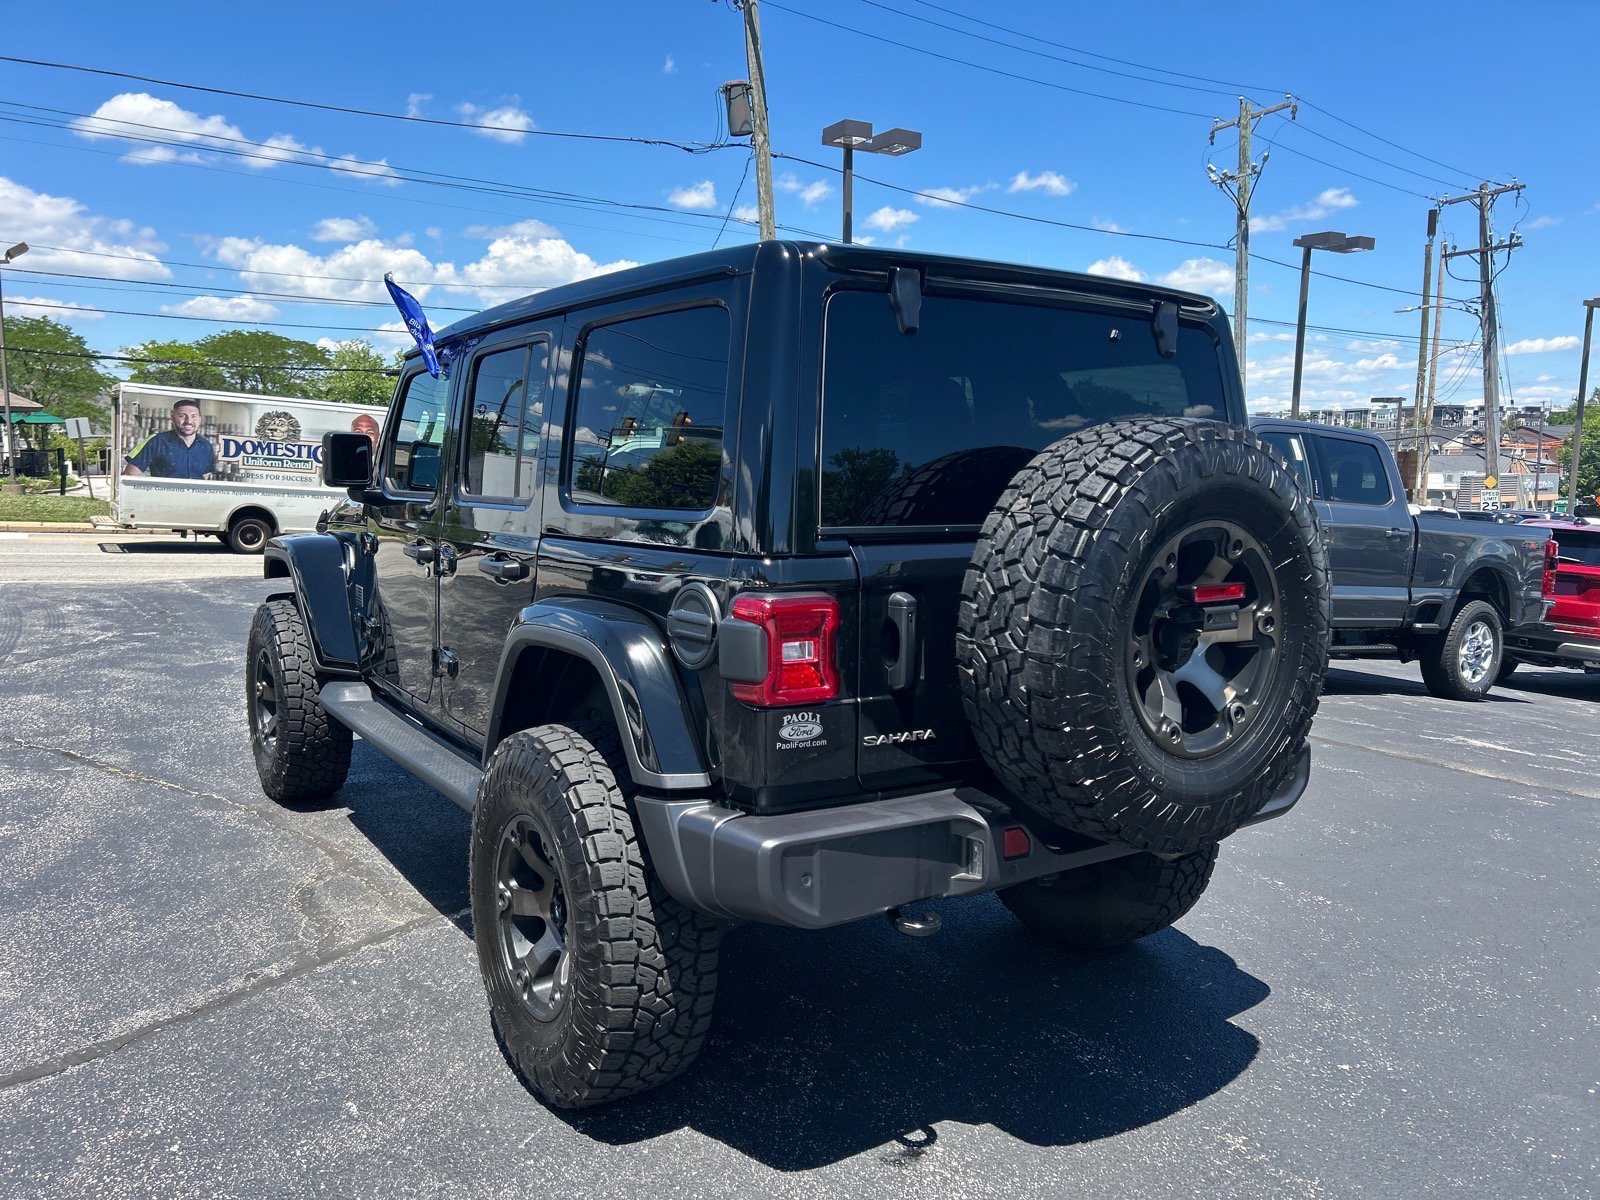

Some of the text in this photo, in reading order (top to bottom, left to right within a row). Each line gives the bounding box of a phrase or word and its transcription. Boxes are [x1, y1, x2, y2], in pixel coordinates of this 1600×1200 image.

[222, 438, 323, 465] DOMESTIC
[244, 456, 312, 470] Uniform Rental
[265, 473, 281, 481] FOR
[1482, 501, 1499, 511] 25
[783, 711, 821, 726] PAOLI
[789, 725, 815, 737] Ford
[863, 728, 937, 747] SAHARA
[776, 739, 827, 750] PaoliFord.com
